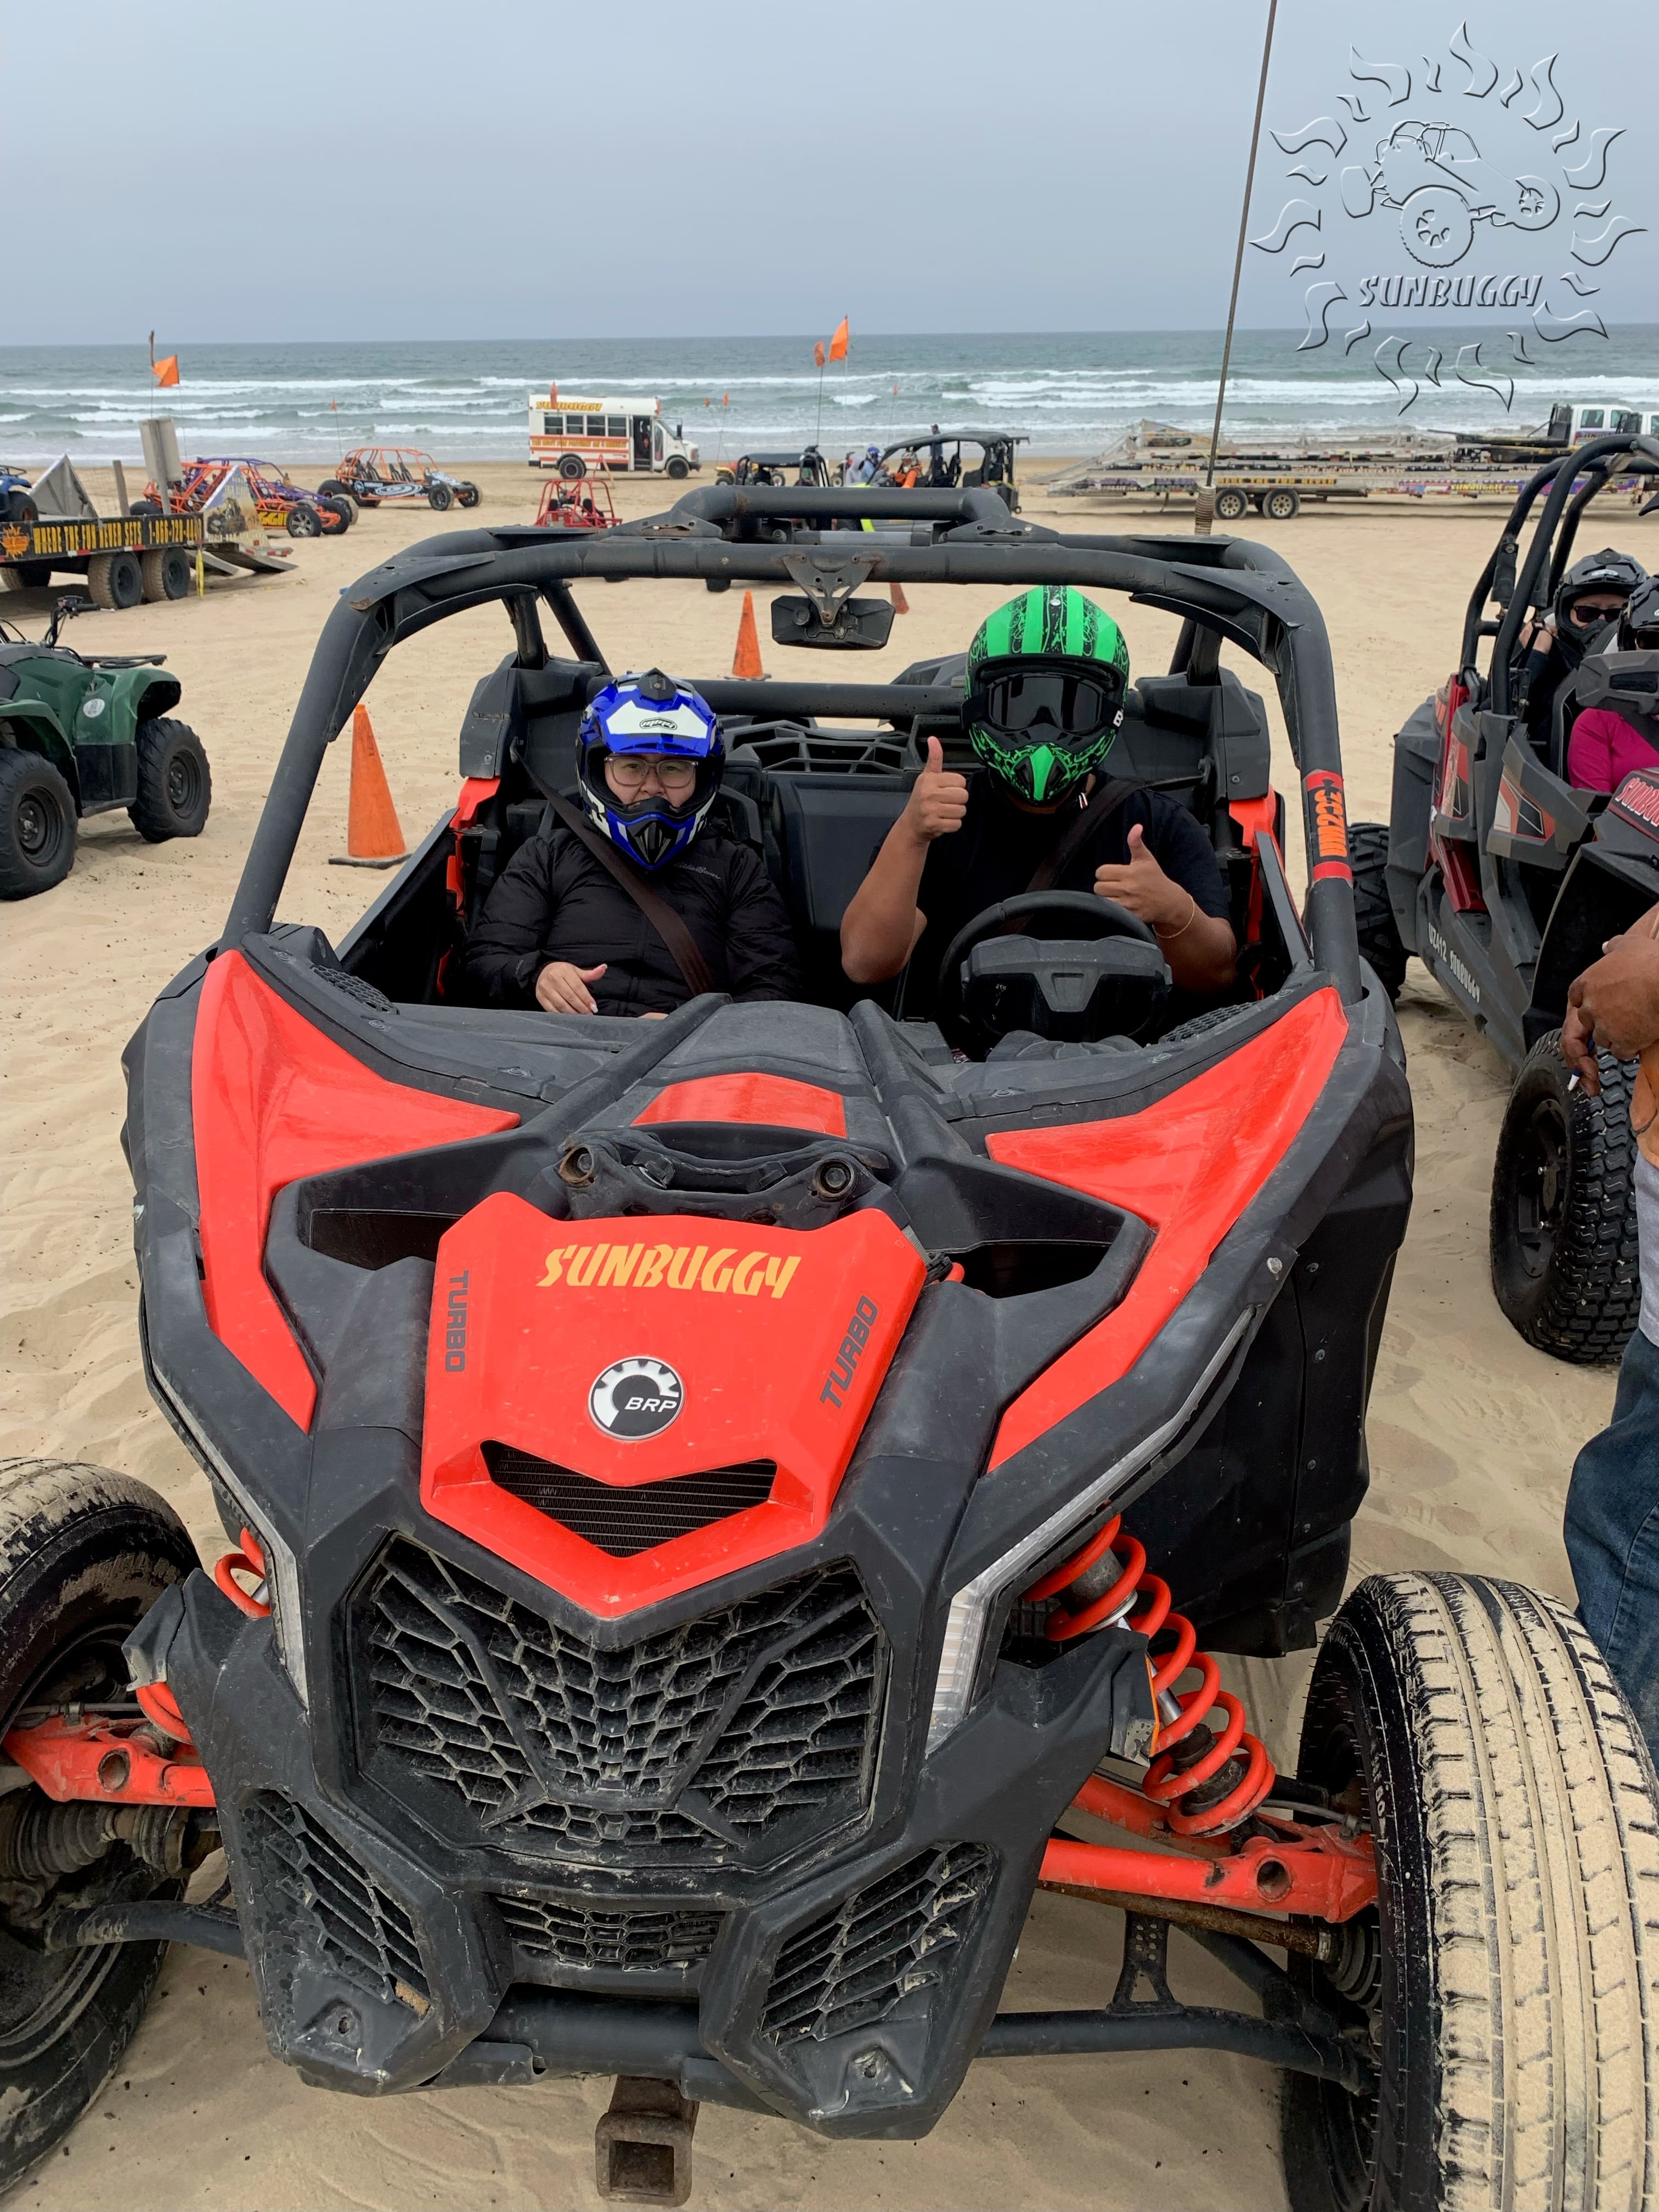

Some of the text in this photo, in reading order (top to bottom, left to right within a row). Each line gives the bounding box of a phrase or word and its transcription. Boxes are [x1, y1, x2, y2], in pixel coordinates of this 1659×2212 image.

[33, 526, 63, 554] WHERE
[64, 525, 80, 551] THE
[82, 524, 97, 550] FUN
[125, 521, 142, 546] SETS
[1429, 922, 1480, 1003] UZ412 SUNBUGGY
[535, 1243, 802, 1299] SUNBUGGY
[445, 1270, 469, 1372] TURBO
[820, 1295, 878, 1409] TURBO
[624, 1396, 678, 1413] BRP
